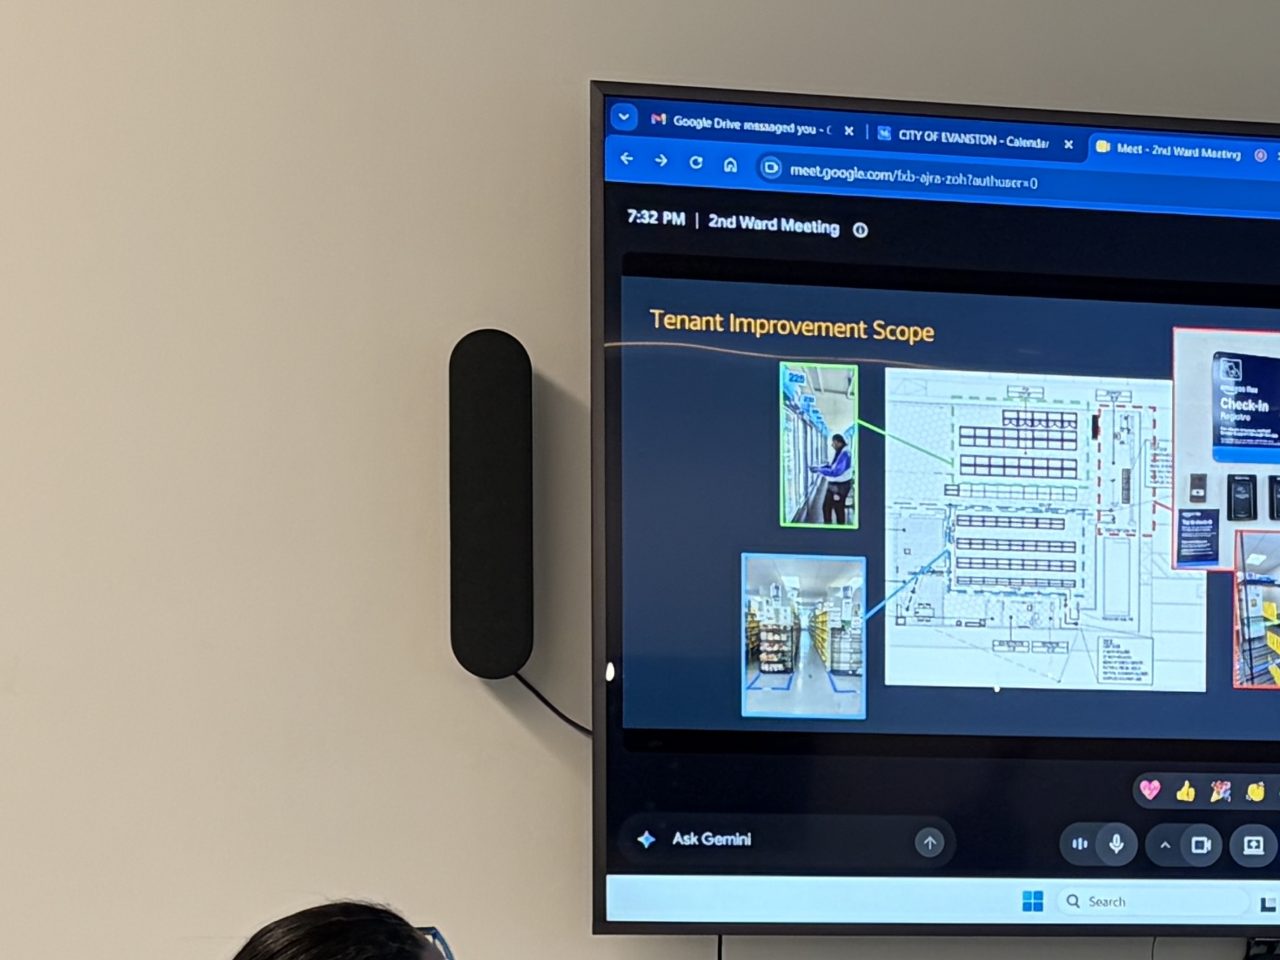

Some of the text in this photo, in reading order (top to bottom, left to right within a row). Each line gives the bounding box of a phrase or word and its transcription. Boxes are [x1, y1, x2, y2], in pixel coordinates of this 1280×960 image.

[673, 115, 712, 130] Google
[714, 117, 741, 130] Drive
[797, 125, 817, 136] you
[899, 129, 923, 141] CITY
[924, 130, 940, 142] OF
[941, 131, 997, 146] EVANSTON
[1117, 142, 1142, 154] Meet
[1152, 144, 1171, 156] 2nd
[1173, 146, 1199, 158] Ward
[1201, 148, 1242, 162] Meeting
[627, 209, 686, 226] 7:32 PM
[708, 213, 840, 239] 2nd Ward Meeting
[649, 308, 935, 345] Tenant Improvement Scope
[672, 831, 752, 846] Ask Gemini
[1088, 895, 1126, 908] Search
